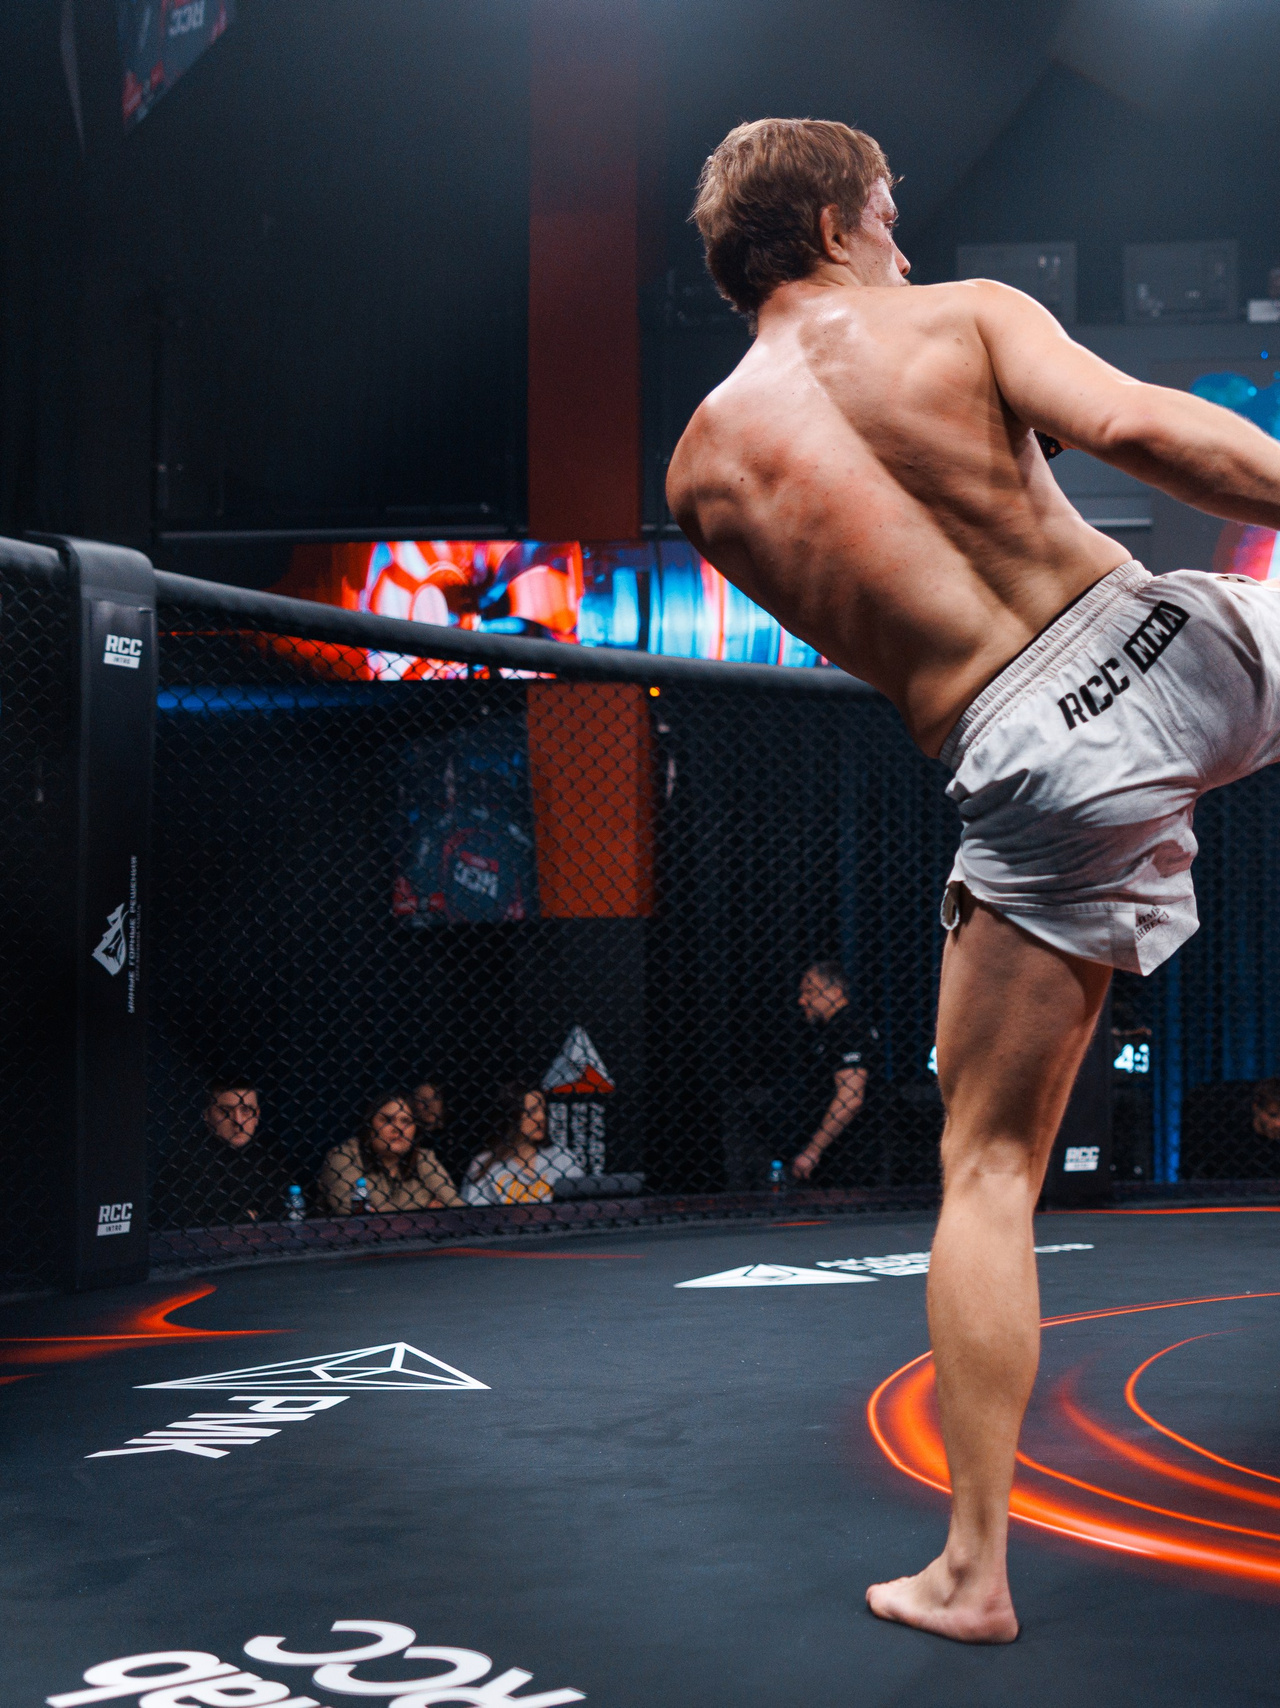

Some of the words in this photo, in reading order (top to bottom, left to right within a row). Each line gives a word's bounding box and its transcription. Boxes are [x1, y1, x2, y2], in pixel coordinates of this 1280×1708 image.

[105, 633, 143, 656] RCC
[1057, 657, 1131, 731] RCC
[1131, 606, 1183, 665] MMA
[1065, 1147, 1100, 1161] RCC
[98, 1202, 133, 1223] RCC
